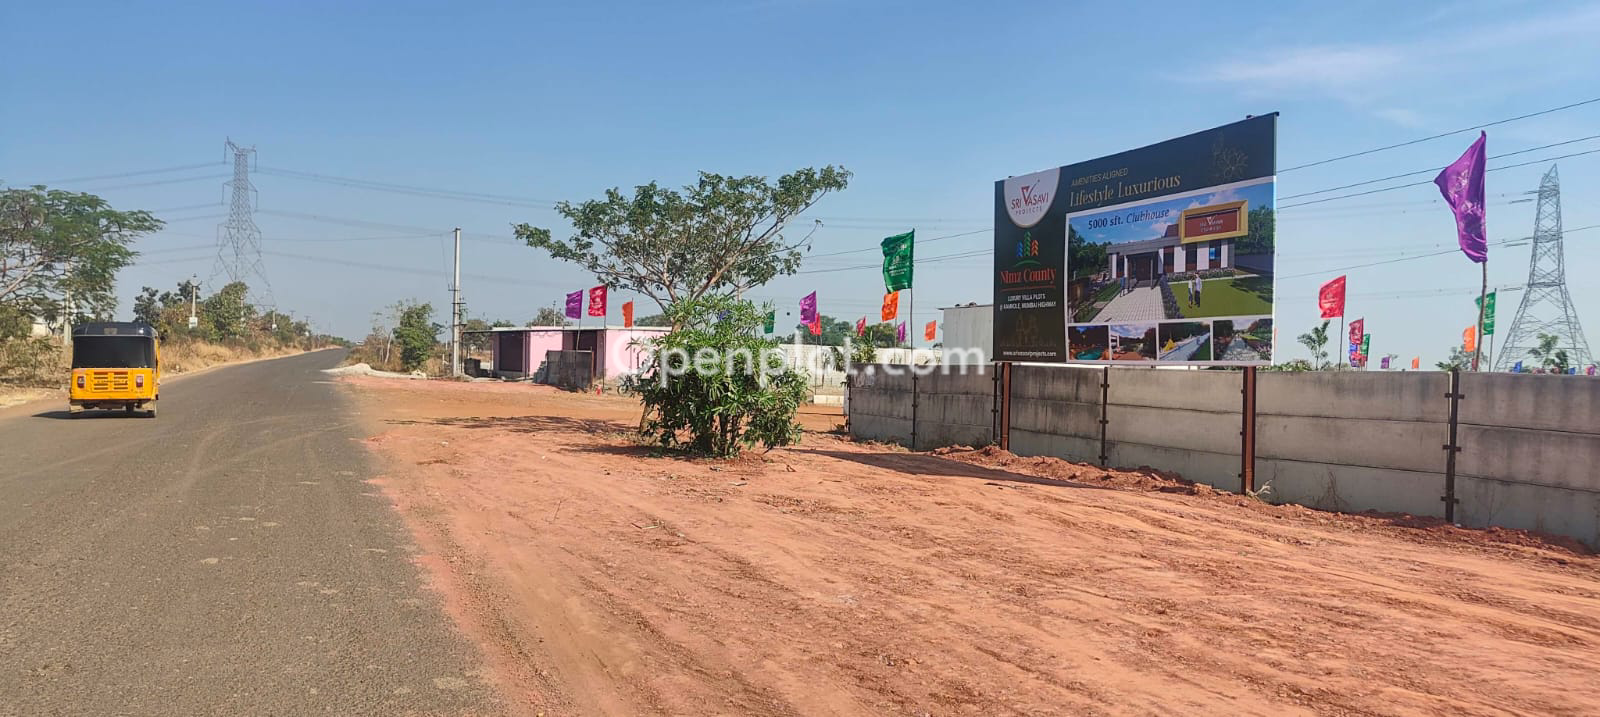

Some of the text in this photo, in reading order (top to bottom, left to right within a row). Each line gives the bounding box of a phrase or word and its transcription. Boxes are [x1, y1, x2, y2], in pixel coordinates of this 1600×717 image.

[1072, 168, 1128, 186] AMENITIES ALIGNED
[1011, 182, 1049, 210] SRI VASAVI
[1070, 175, 1181, 207] Lifestyle Luxurious
[1088, 209, 1170, 230] 5000 sft. Clubhouse
[1023, 267, 1056, 285] County
